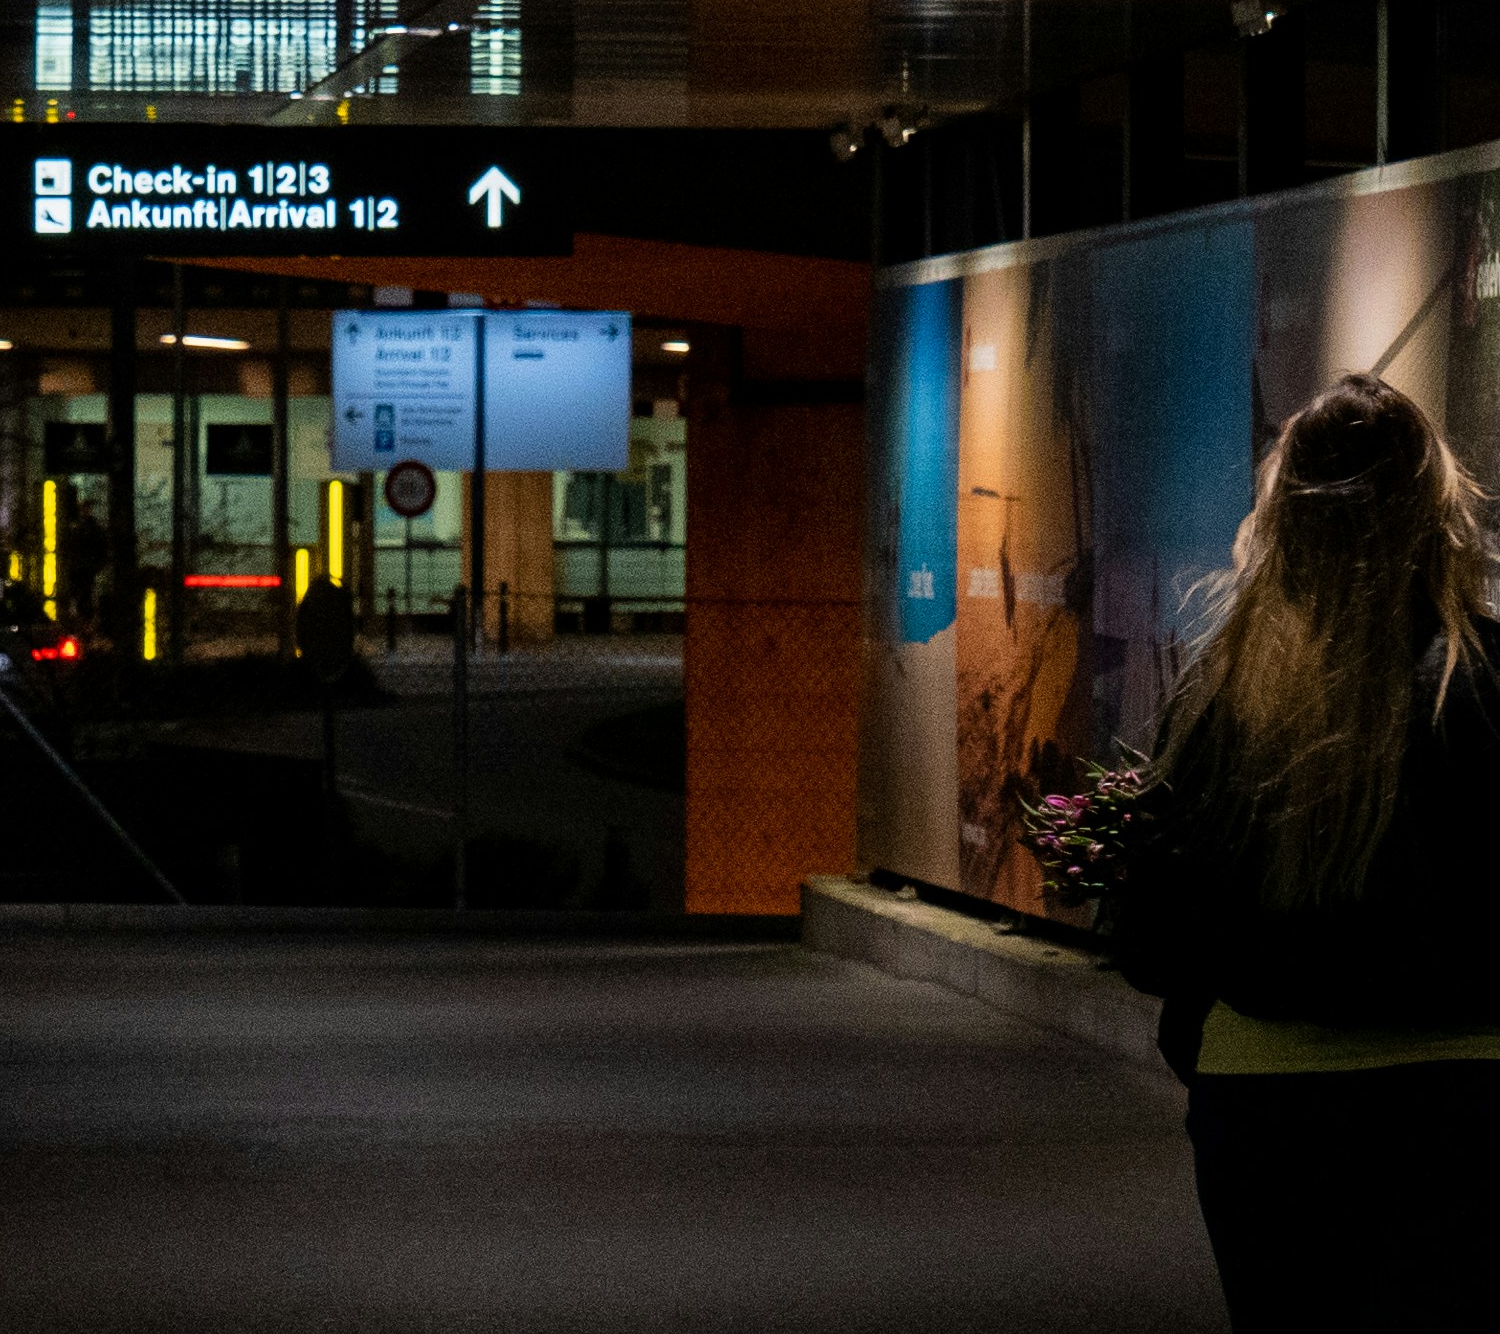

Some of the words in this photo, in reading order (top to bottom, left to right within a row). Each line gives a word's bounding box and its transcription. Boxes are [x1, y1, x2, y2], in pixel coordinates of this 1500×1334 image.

[87, 164, 237, 195] Check-in
[248, 161, 331, 196] 1|2|3
[349, 197, 399, 232] 1|2
[513, 323, 579, 342] Services
